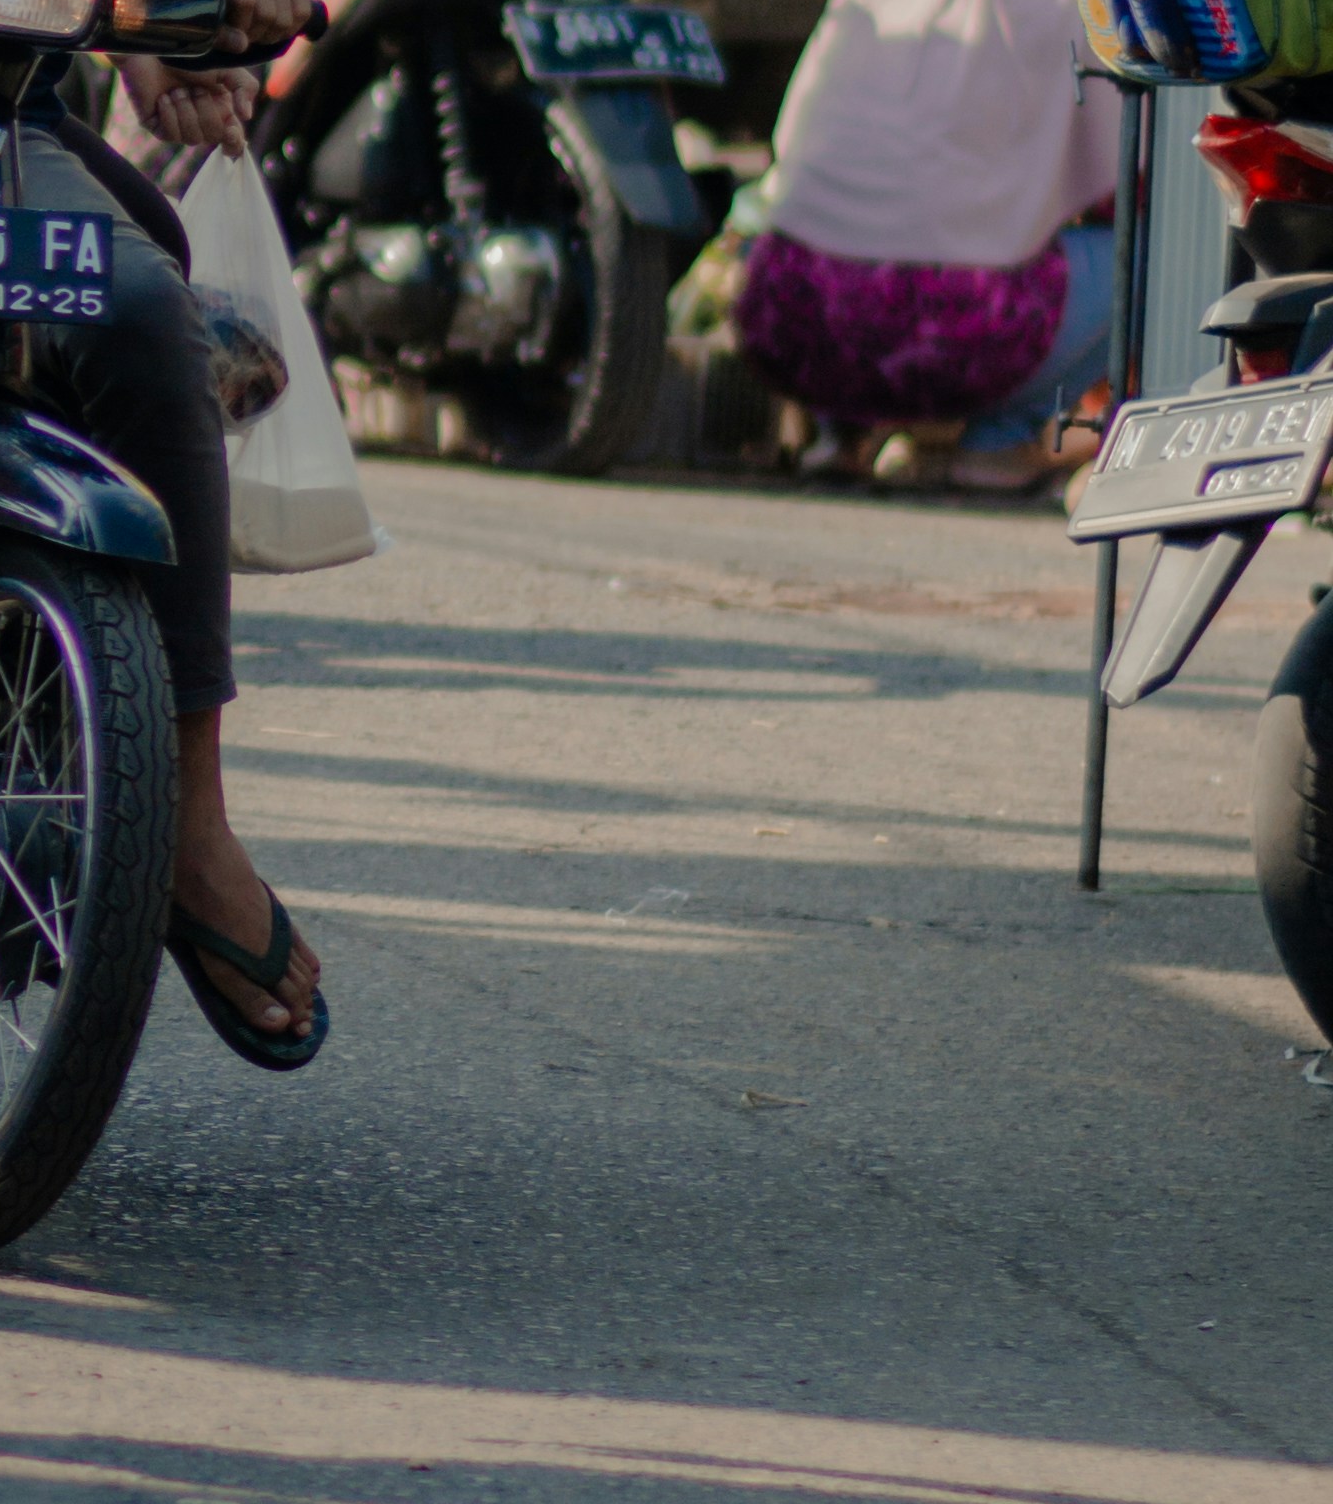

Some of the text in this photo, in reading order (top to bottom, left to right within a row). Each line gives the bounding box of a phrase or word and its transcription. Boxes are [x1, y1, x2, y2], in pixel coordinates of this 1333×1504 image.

[44, 220, 102, 273] FA
[1115, 423, 1149, 470] N
[1159, 409, 1248, 460] 4919
